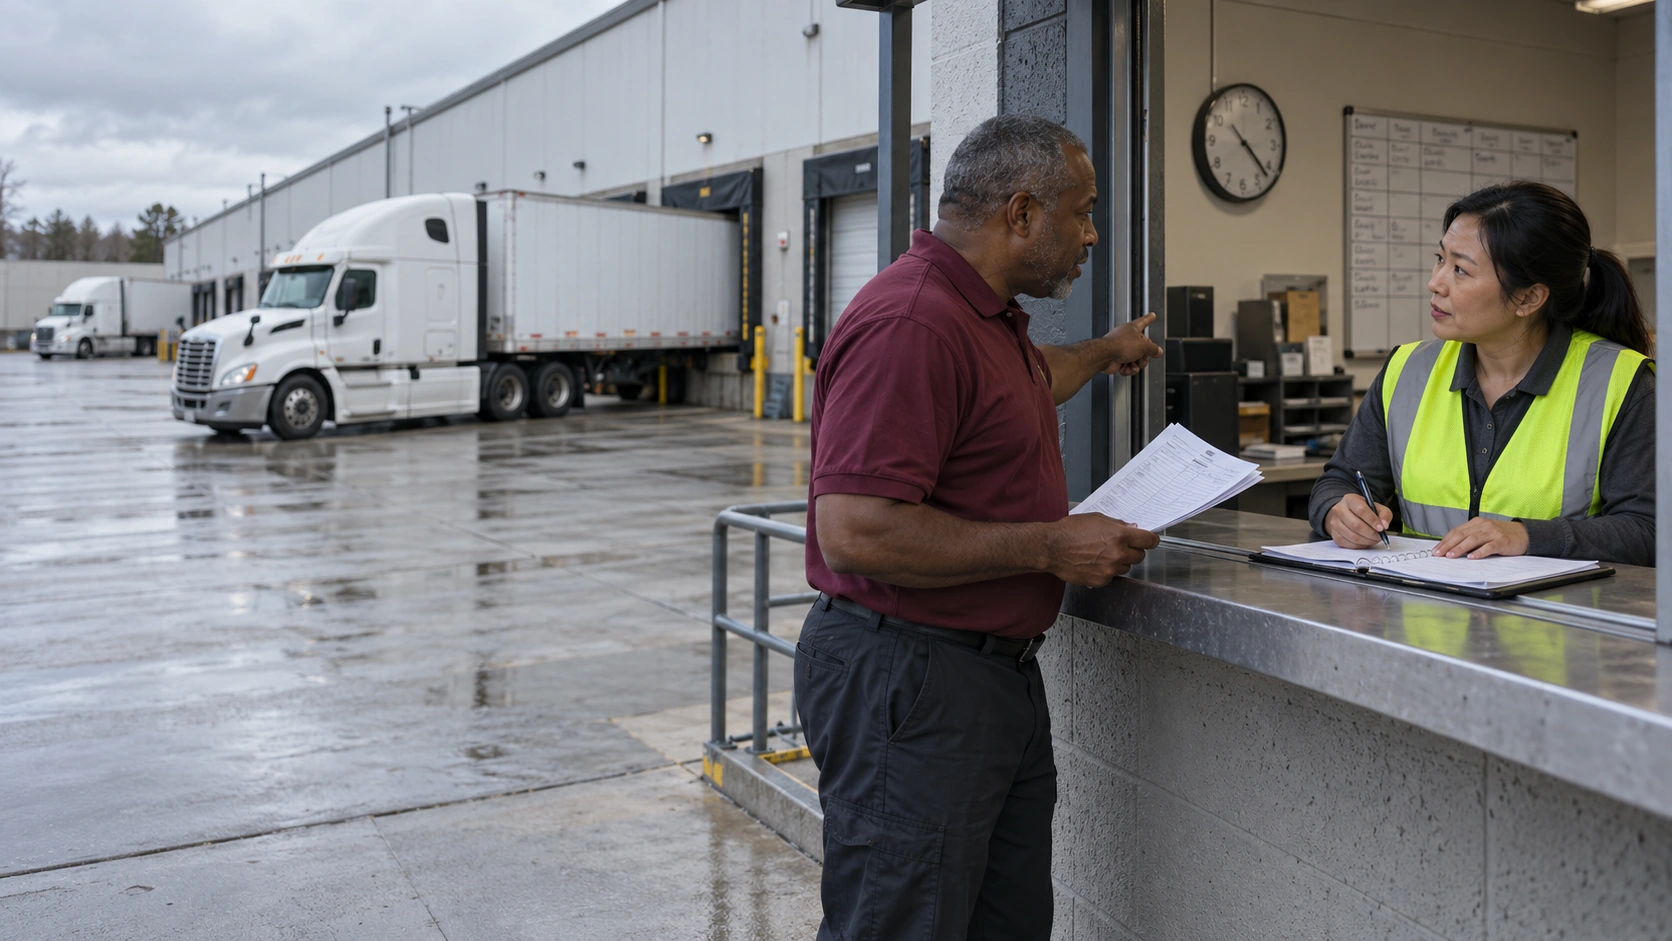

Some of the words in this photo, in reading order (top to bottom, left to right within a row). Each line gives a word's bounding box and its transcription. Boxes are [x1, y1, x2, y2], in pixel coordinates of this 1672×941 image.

[1225, 100, 1232, 112] 11
[1239, 96, 1249, 108] 12
[1256, 103, 1260, 114] 1
[1214, 115, 1223, 126] 10
[1266, 118, 1272, 130] 2
[1209, 135, 1215, 146] 9
[1271, 140, 1276, 151] 3
[1214, 157, 1221, 168] 8
[1225, 172, 1232, 184] 7
[1240, 178, 1246, 190] 6
[1255, 174, 1261, 186] 5
